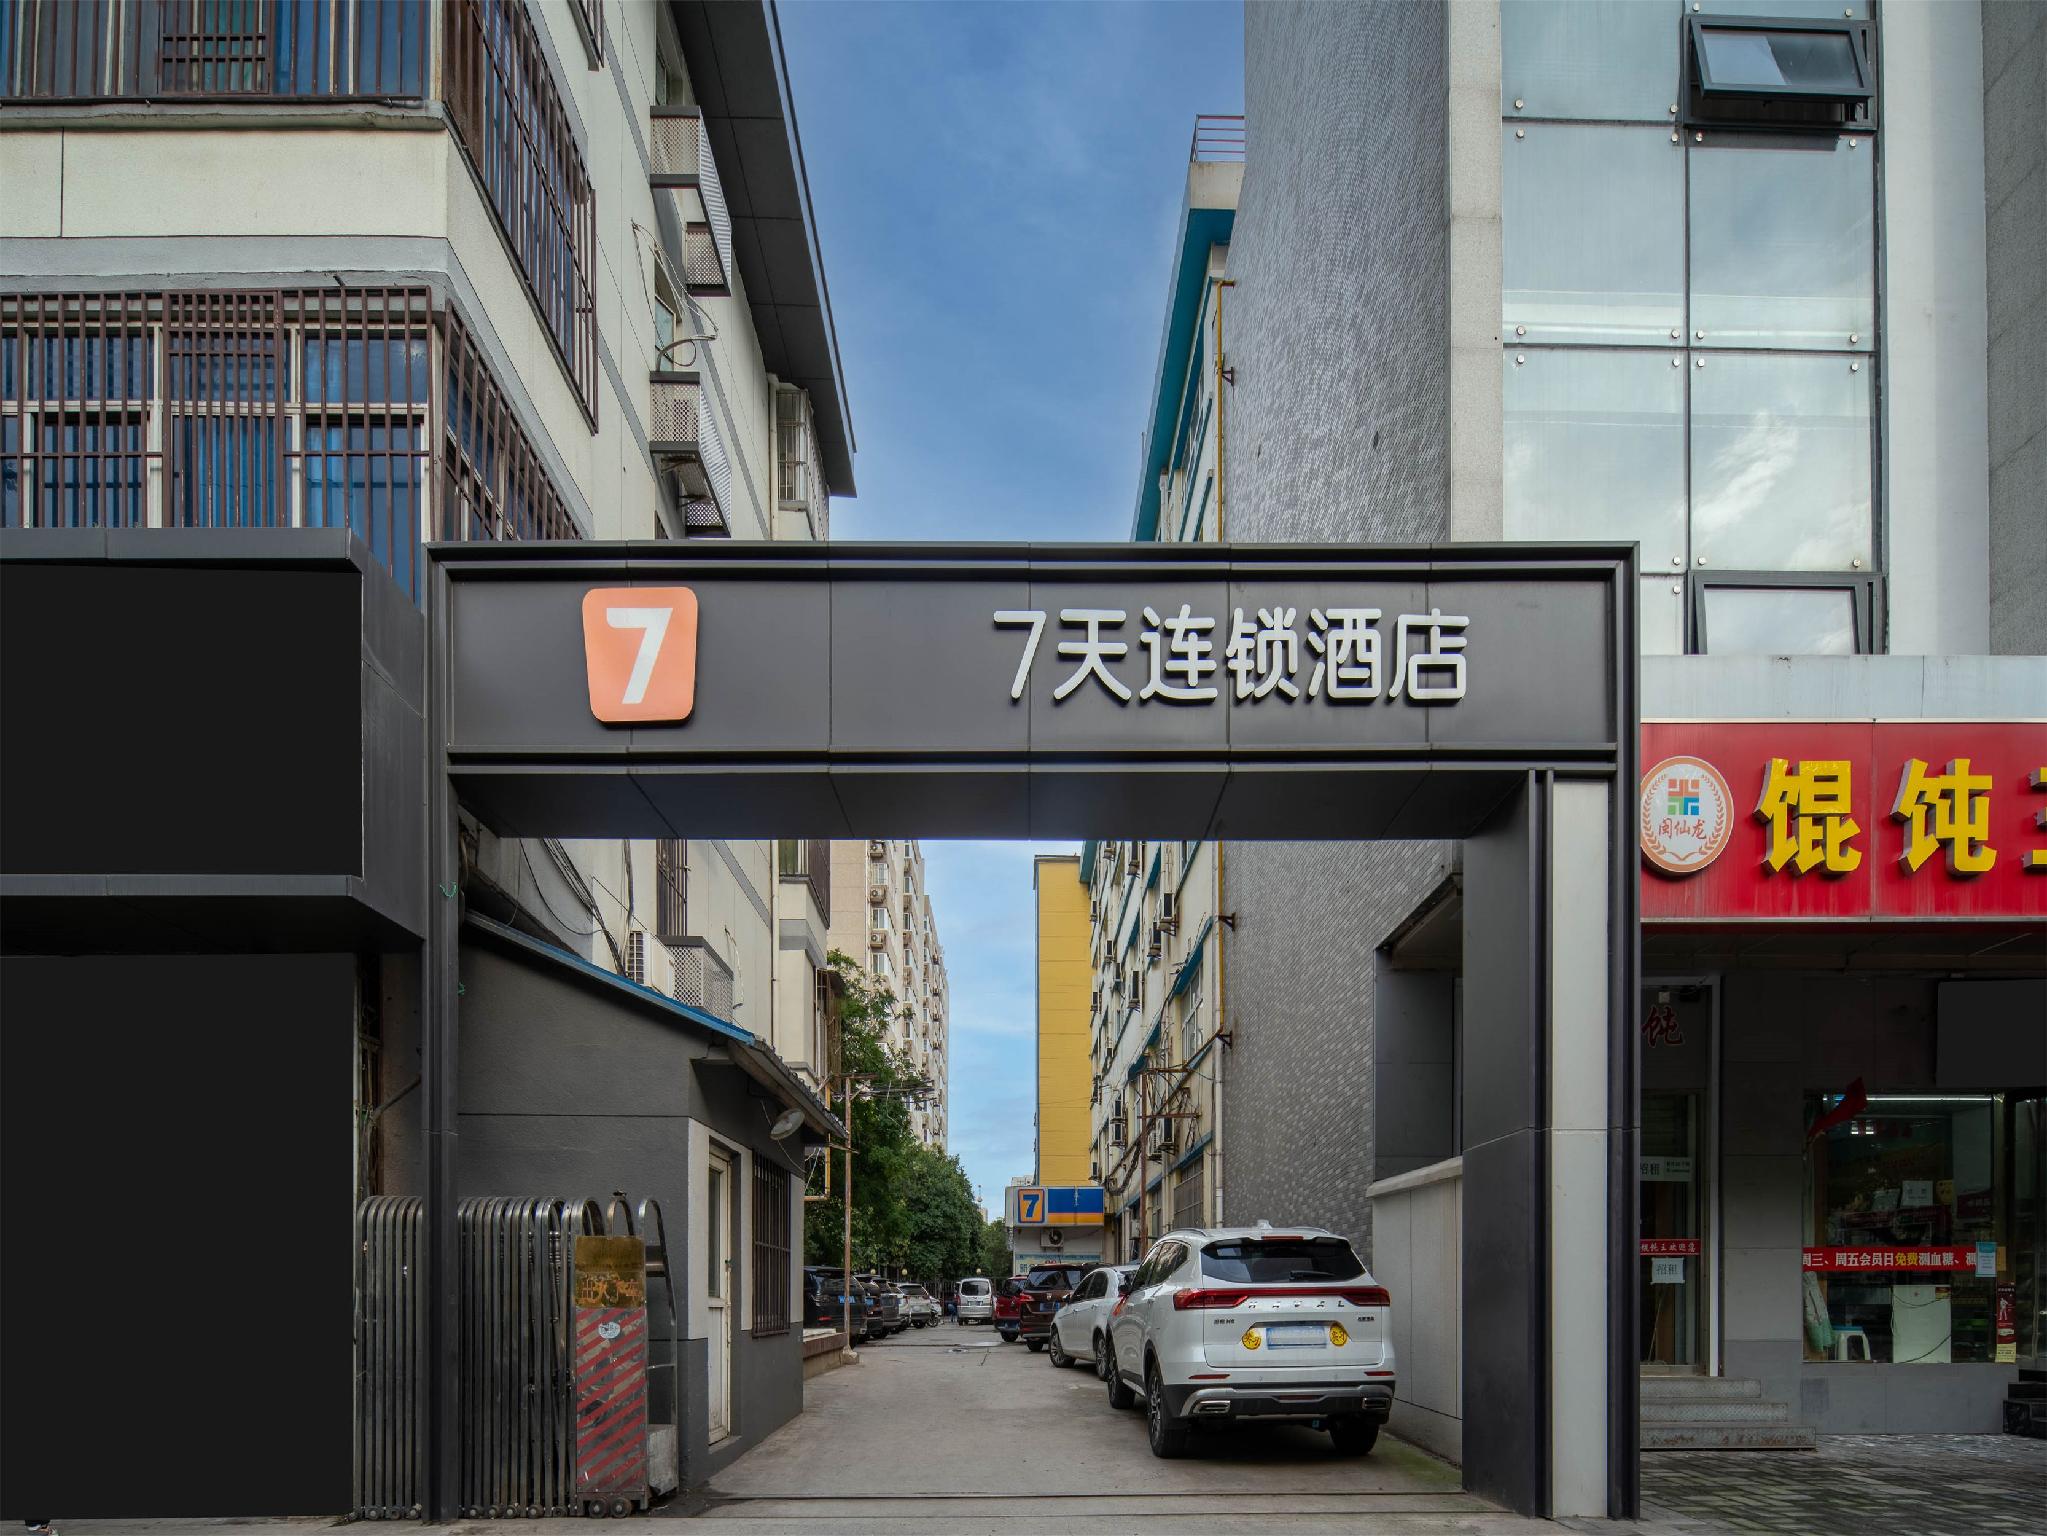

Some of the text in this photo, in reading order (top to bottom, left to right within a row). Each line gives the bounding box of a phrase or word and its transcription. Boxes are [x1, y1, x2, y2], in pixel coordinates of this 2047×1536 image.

[606, 607, 673, 705] 7
[993, 604, 1470, 700] 7天连锁酒店
[1022, 1194, 1040, 1218] 7
